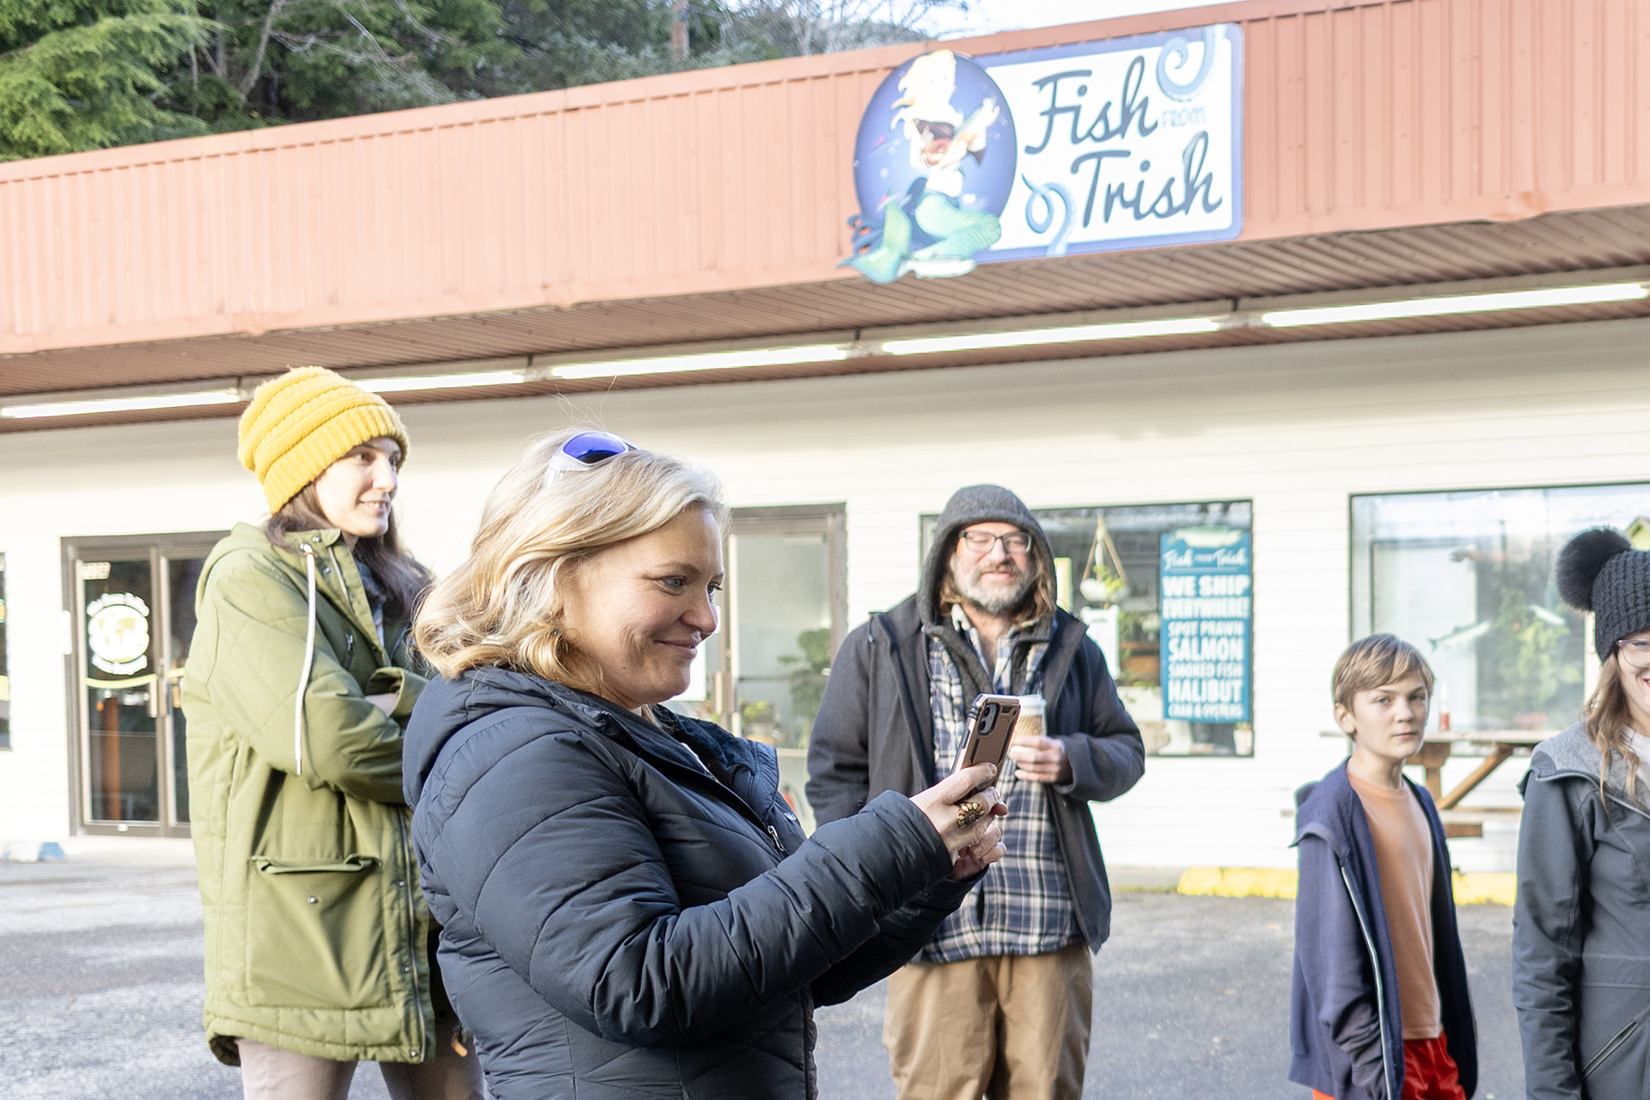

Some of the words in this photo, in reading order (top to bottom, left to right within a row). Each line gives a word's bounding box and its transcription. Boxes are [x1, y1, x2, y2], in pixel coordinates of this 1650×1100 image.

[1025, 55, 1158, 154] Fish
[1071, 131, 1222, 228] Trish
[1162, 575, 1197, 597] WE
[1198, 574, 1250, 597] SHIP
[1162, 597, 1250, 619] EVERYWHERE!
[1168, 620, 1199, 638] SPOT
[1200, 620, 1244, 637] PRAWN
[1168, 636, 1244, 662] SALMON
[1168, 661, 1216, 679] SMOKED
[1216, 661, 1243, 679] FISH
[1168, 678, 1243, 703] HALIBUT
